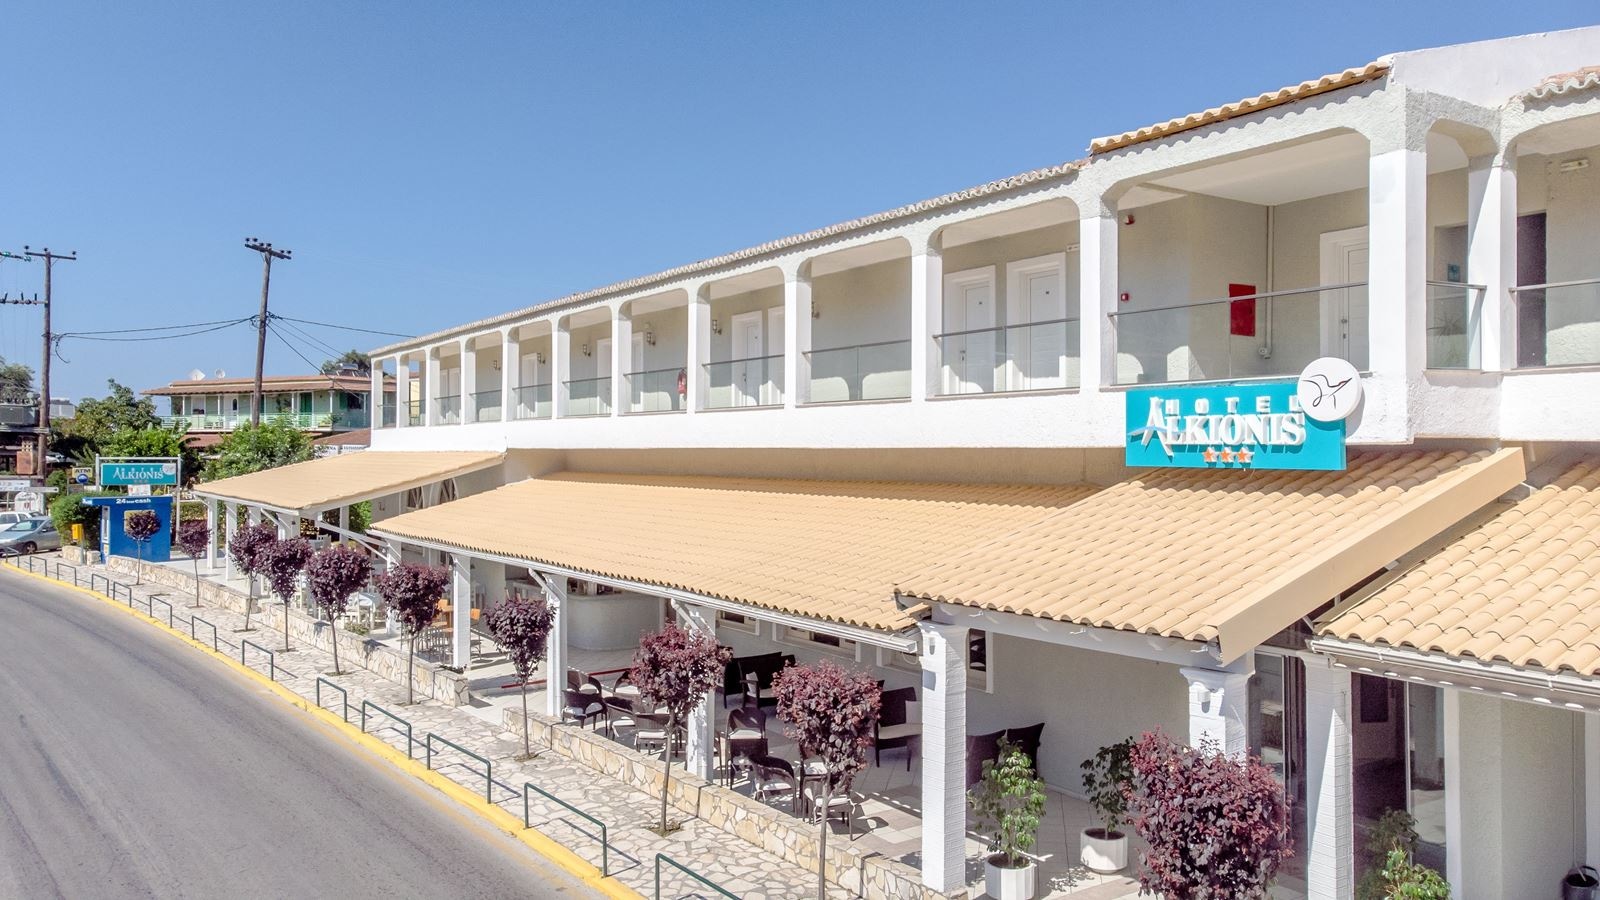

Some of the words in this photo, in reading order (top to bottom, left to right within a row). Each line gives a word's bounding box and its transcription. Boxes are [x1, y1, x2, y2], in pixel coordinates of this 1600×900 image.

[1165, 395, 1303, 415] HOTEL
[1128, 396, 1306, 457] ALKIONIS
[113, 467, 163, 480] ALKIONIS
